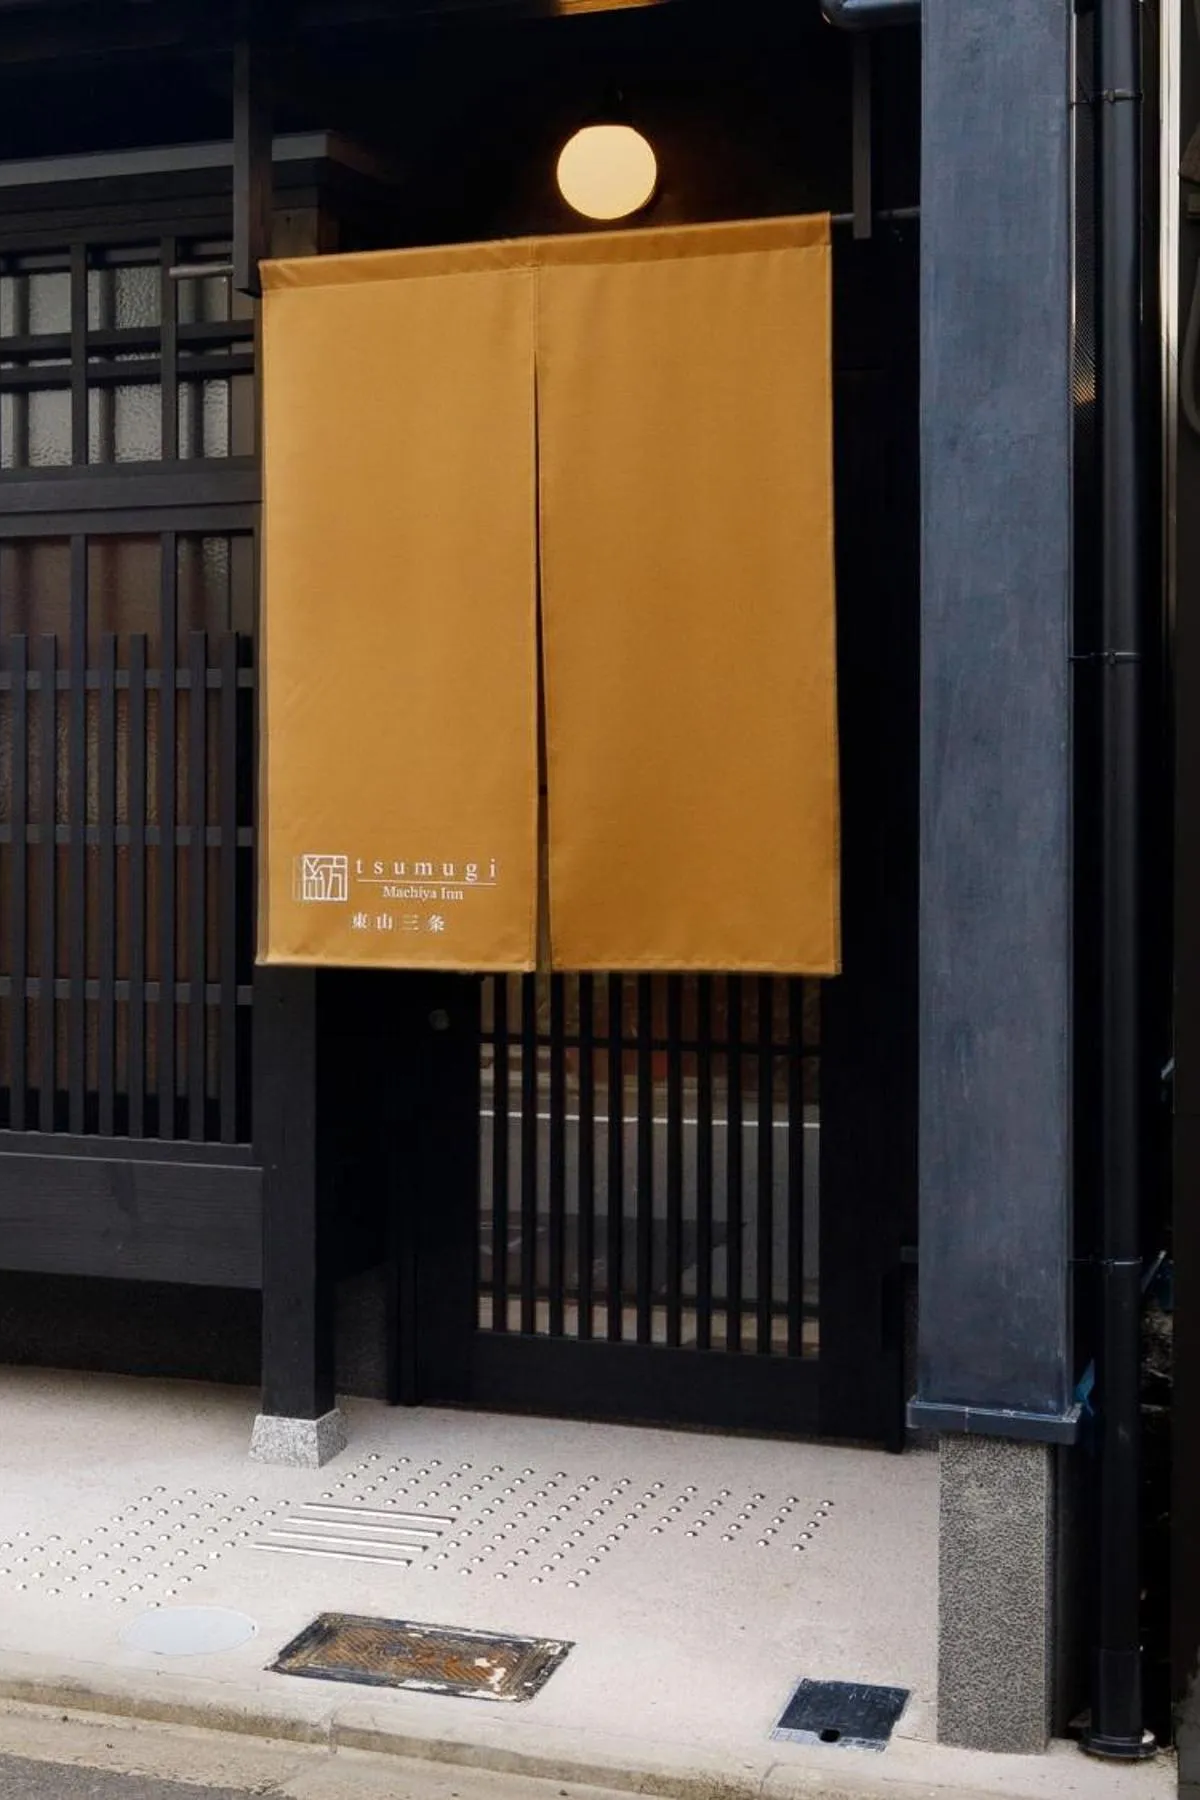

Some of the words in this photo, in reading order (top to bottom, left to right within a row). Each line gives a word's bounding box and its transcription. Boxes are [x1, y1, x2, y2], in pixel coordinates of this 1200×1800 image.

[355, 857, 497, 882] tsumugi
[383, 886, 438, 902] Machiya
[440, 887, 465, 901] Inn
[352, 911, 445, 933] 東山三条
